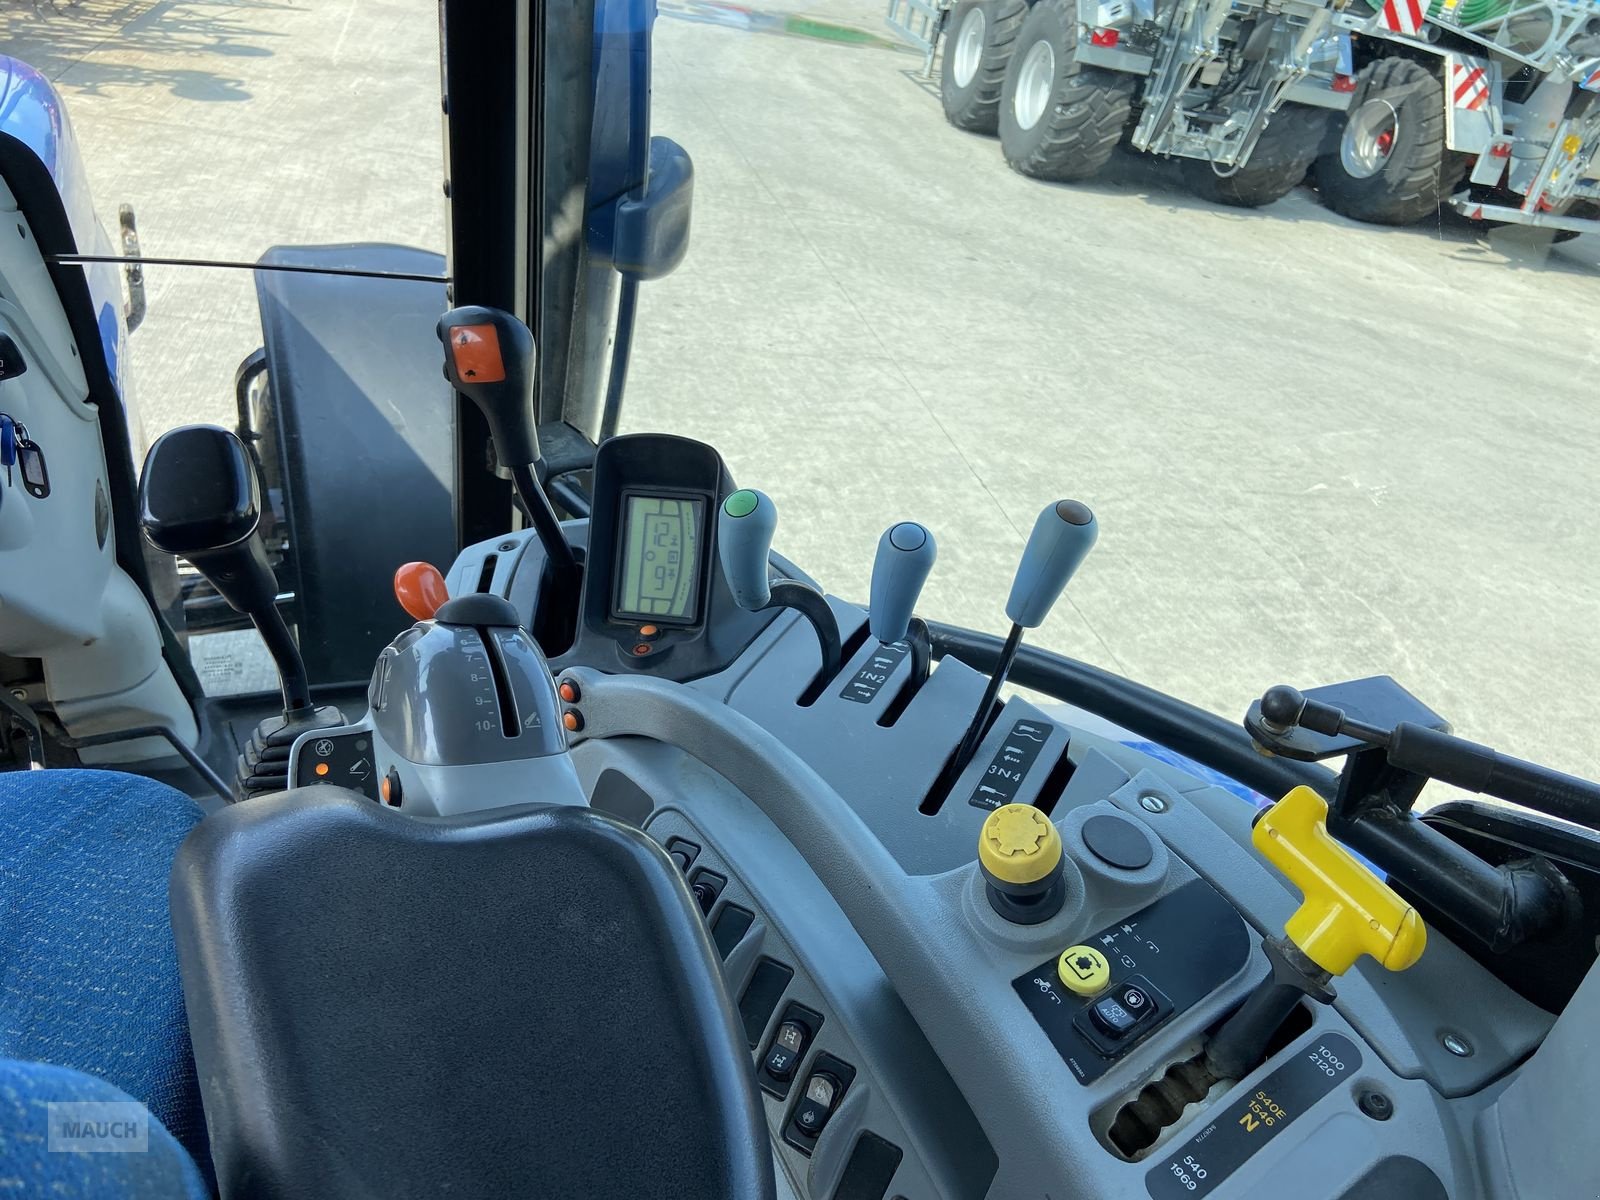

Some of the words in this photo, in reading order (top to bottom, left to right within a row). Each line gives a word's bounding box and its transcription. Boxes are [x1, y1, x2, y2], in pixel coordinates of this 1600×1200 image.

[465, 654, 473, 662] 7
[471, 673, 479, 682] 8
[865, 672, 878, 681] N
[875, 675, 886, 684] 2
[475, 697, 484, 706] 9
[475, 720, 491, 731] 10
[988, 764, 998, 774] 3
[997, 767, 1012, 779] N
[1012, 773, 1021, 782] 4
[1101, 1008, 1119, 1023] AUTO
[1308, 1052, 1336, 1078] 2120
[1318, 1045, 1345, 1071] 1000
[1248, 1100, 1276, 1127] 1546
[1255, 1091, 1287, 1121] 540E
[1238, 1113, 1261, 1133] N
[1183, 1155, 1208, 1179] 540
[1169, 1163, 1197, 1191] 1969
